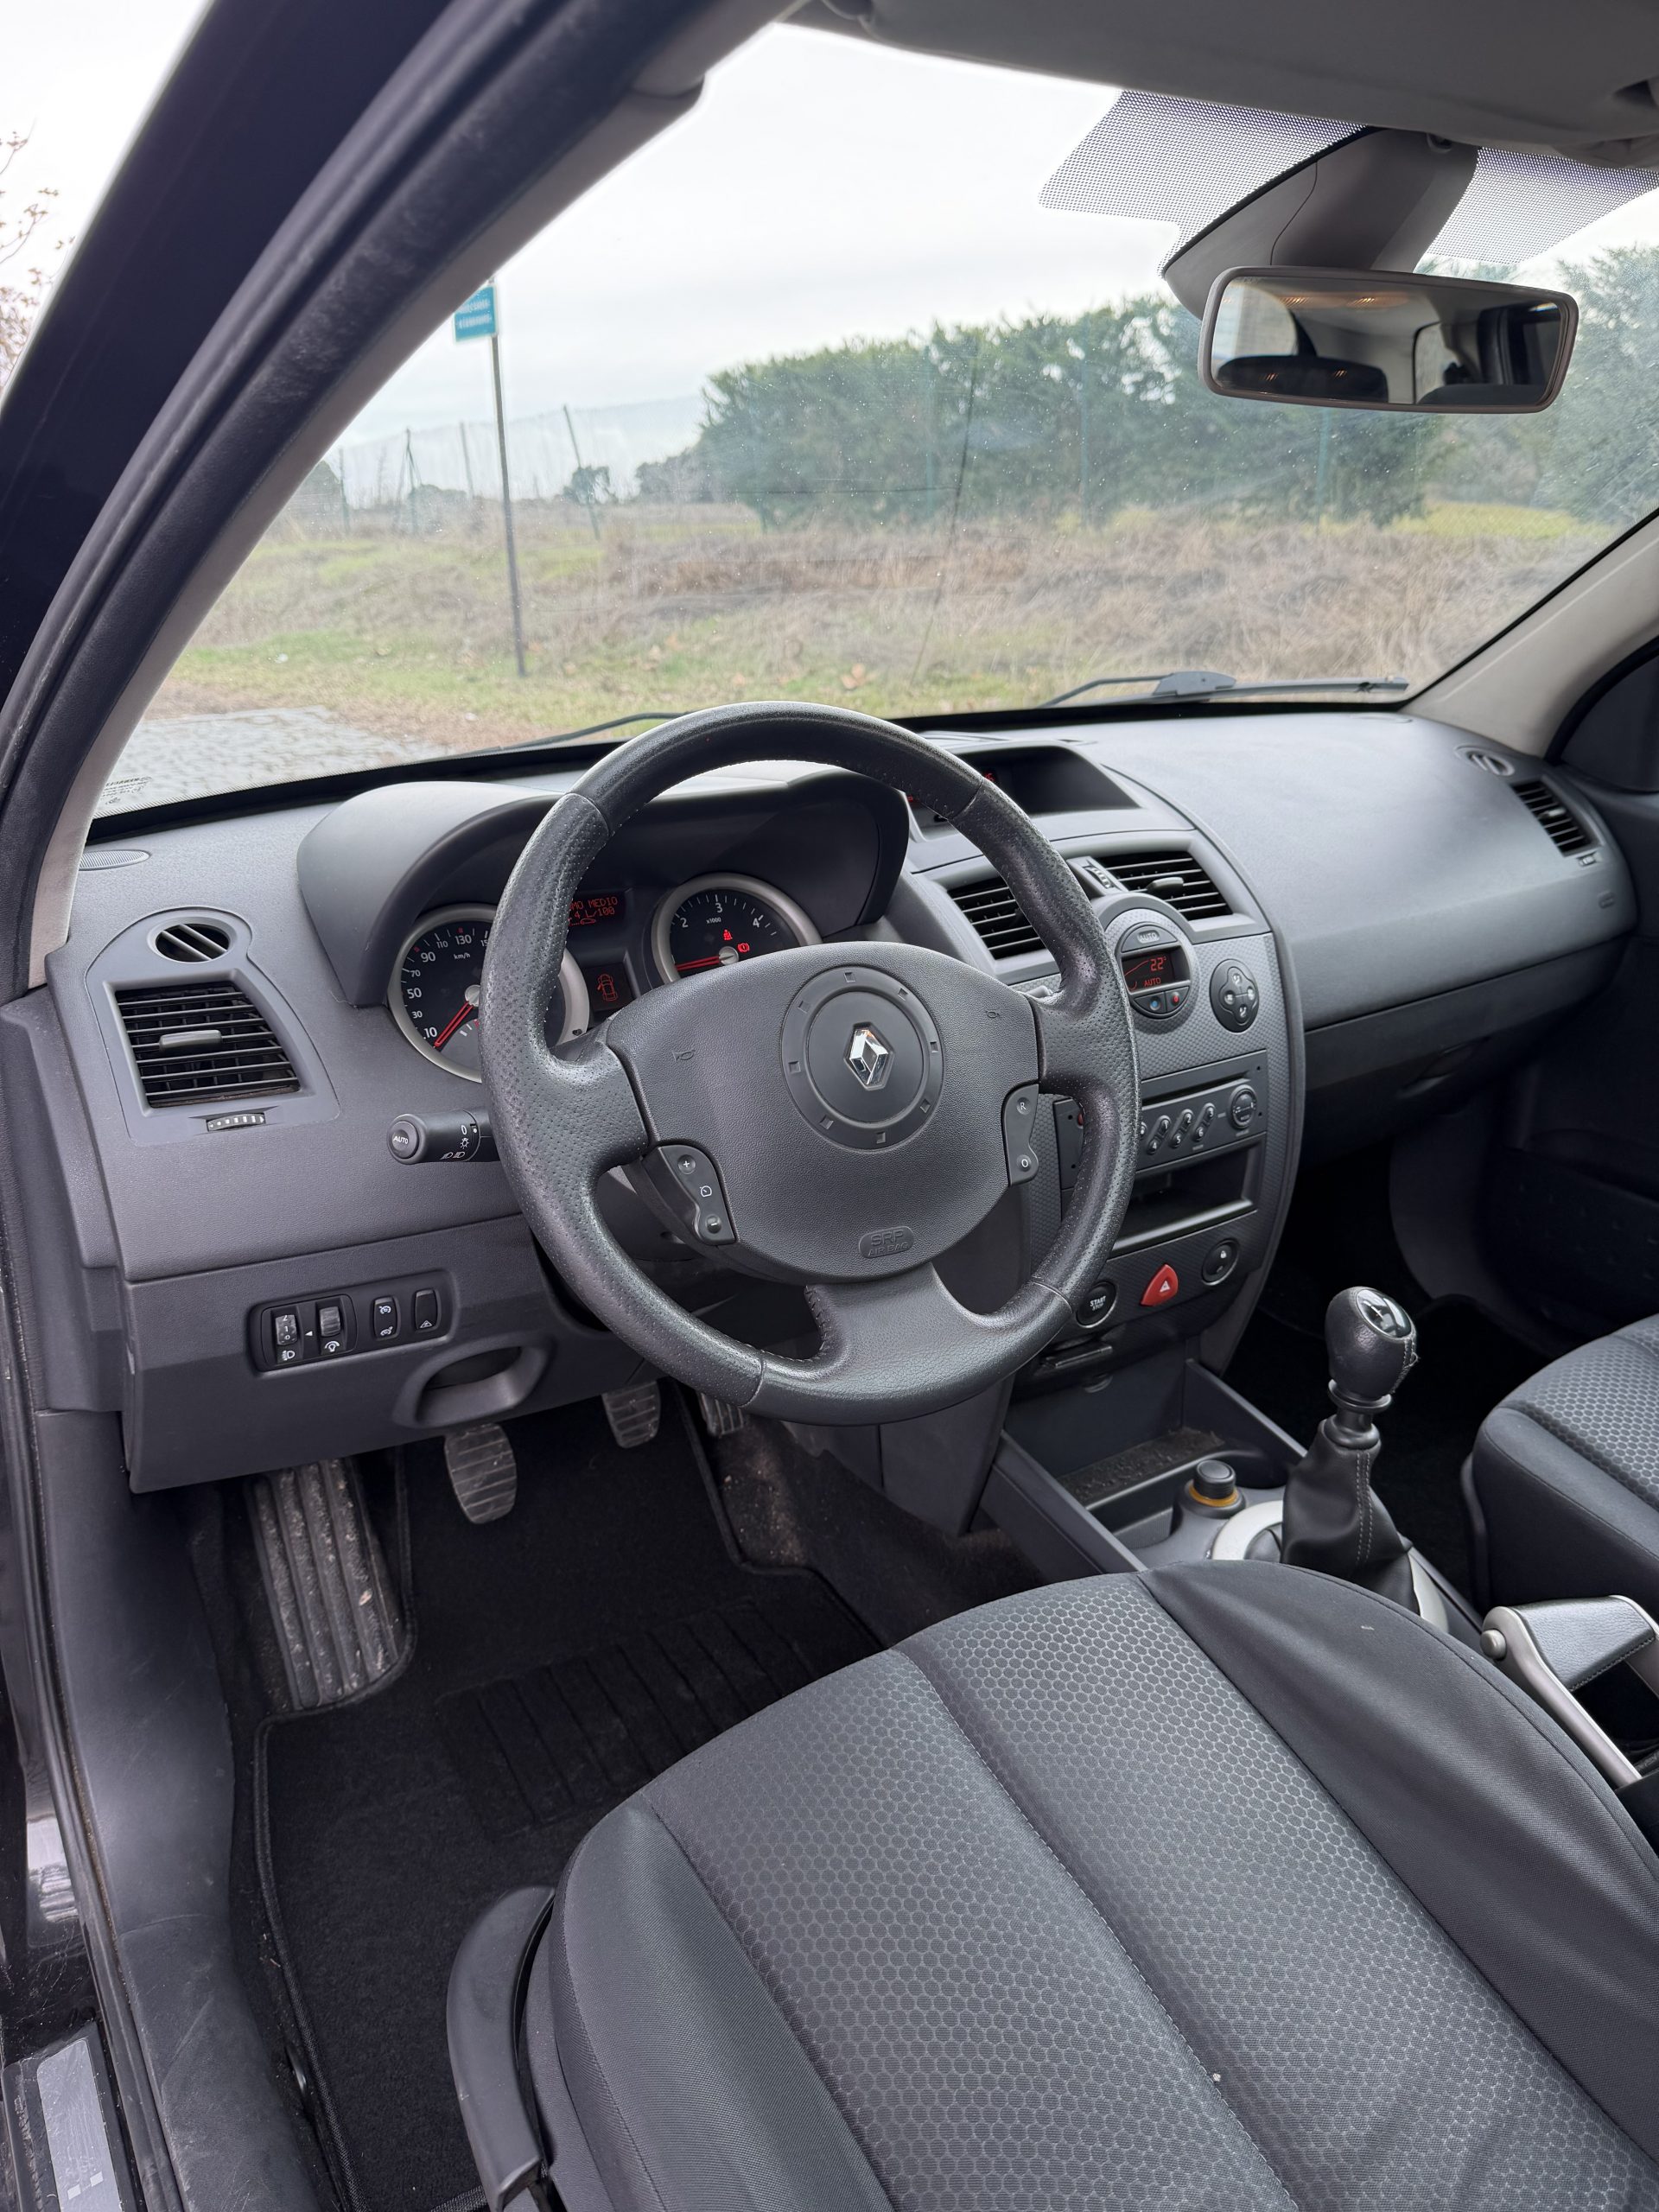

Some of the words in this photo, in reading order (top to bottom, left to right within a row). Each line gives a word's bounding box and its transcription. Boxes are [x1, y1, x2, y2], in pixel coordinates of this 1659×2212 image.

[588, 896, 618, 908] MEDIO
[715, 903, 723, 913] 3
[680, 918, 689, 928] 2
[753, 918, 760, 928] 4
[436, 940, 448, 949] 110
[454, 934, 472, 945] 130
[421, 951, 436, 963] 90
[410, 969, 421, 978] 70
[1143, 977, 1161, 988] AUTO
[407, 987, 423, 999] 50
[411, 1010, 423, 1019] 30
[423, 1027, 438, 1039] 10
[1020, 1102, 1027, 1110] R
[393, 1135, 409, 1144] AUTO
[871, 1230, 904, 1246] SRP
[1090, 1296, 1106, 1306] START
